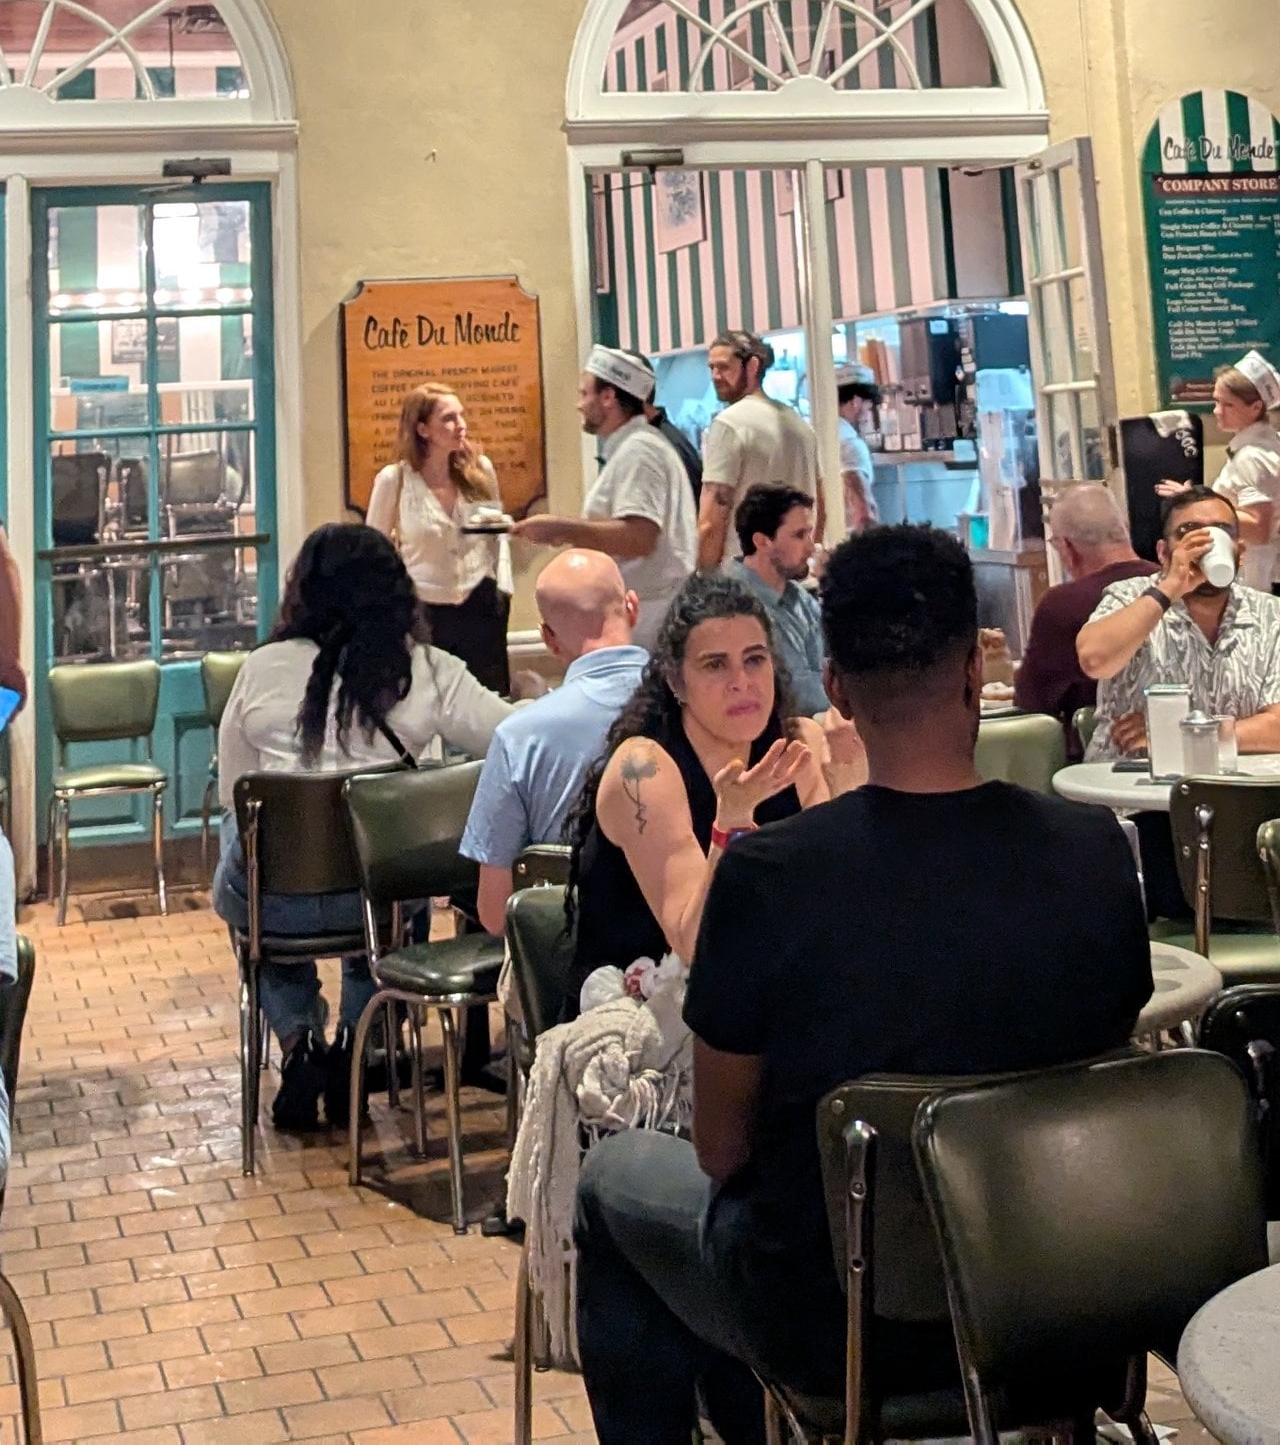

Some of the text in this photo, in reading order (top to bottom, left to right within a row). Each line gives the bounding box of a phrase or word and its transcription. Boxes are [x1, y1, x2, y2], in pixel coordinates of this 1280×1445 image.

[1199, 136, 1222, 162] Du
[1227, 133, 1275, 162] Monde
[363, 311, 521, 350] Café Du Monde
